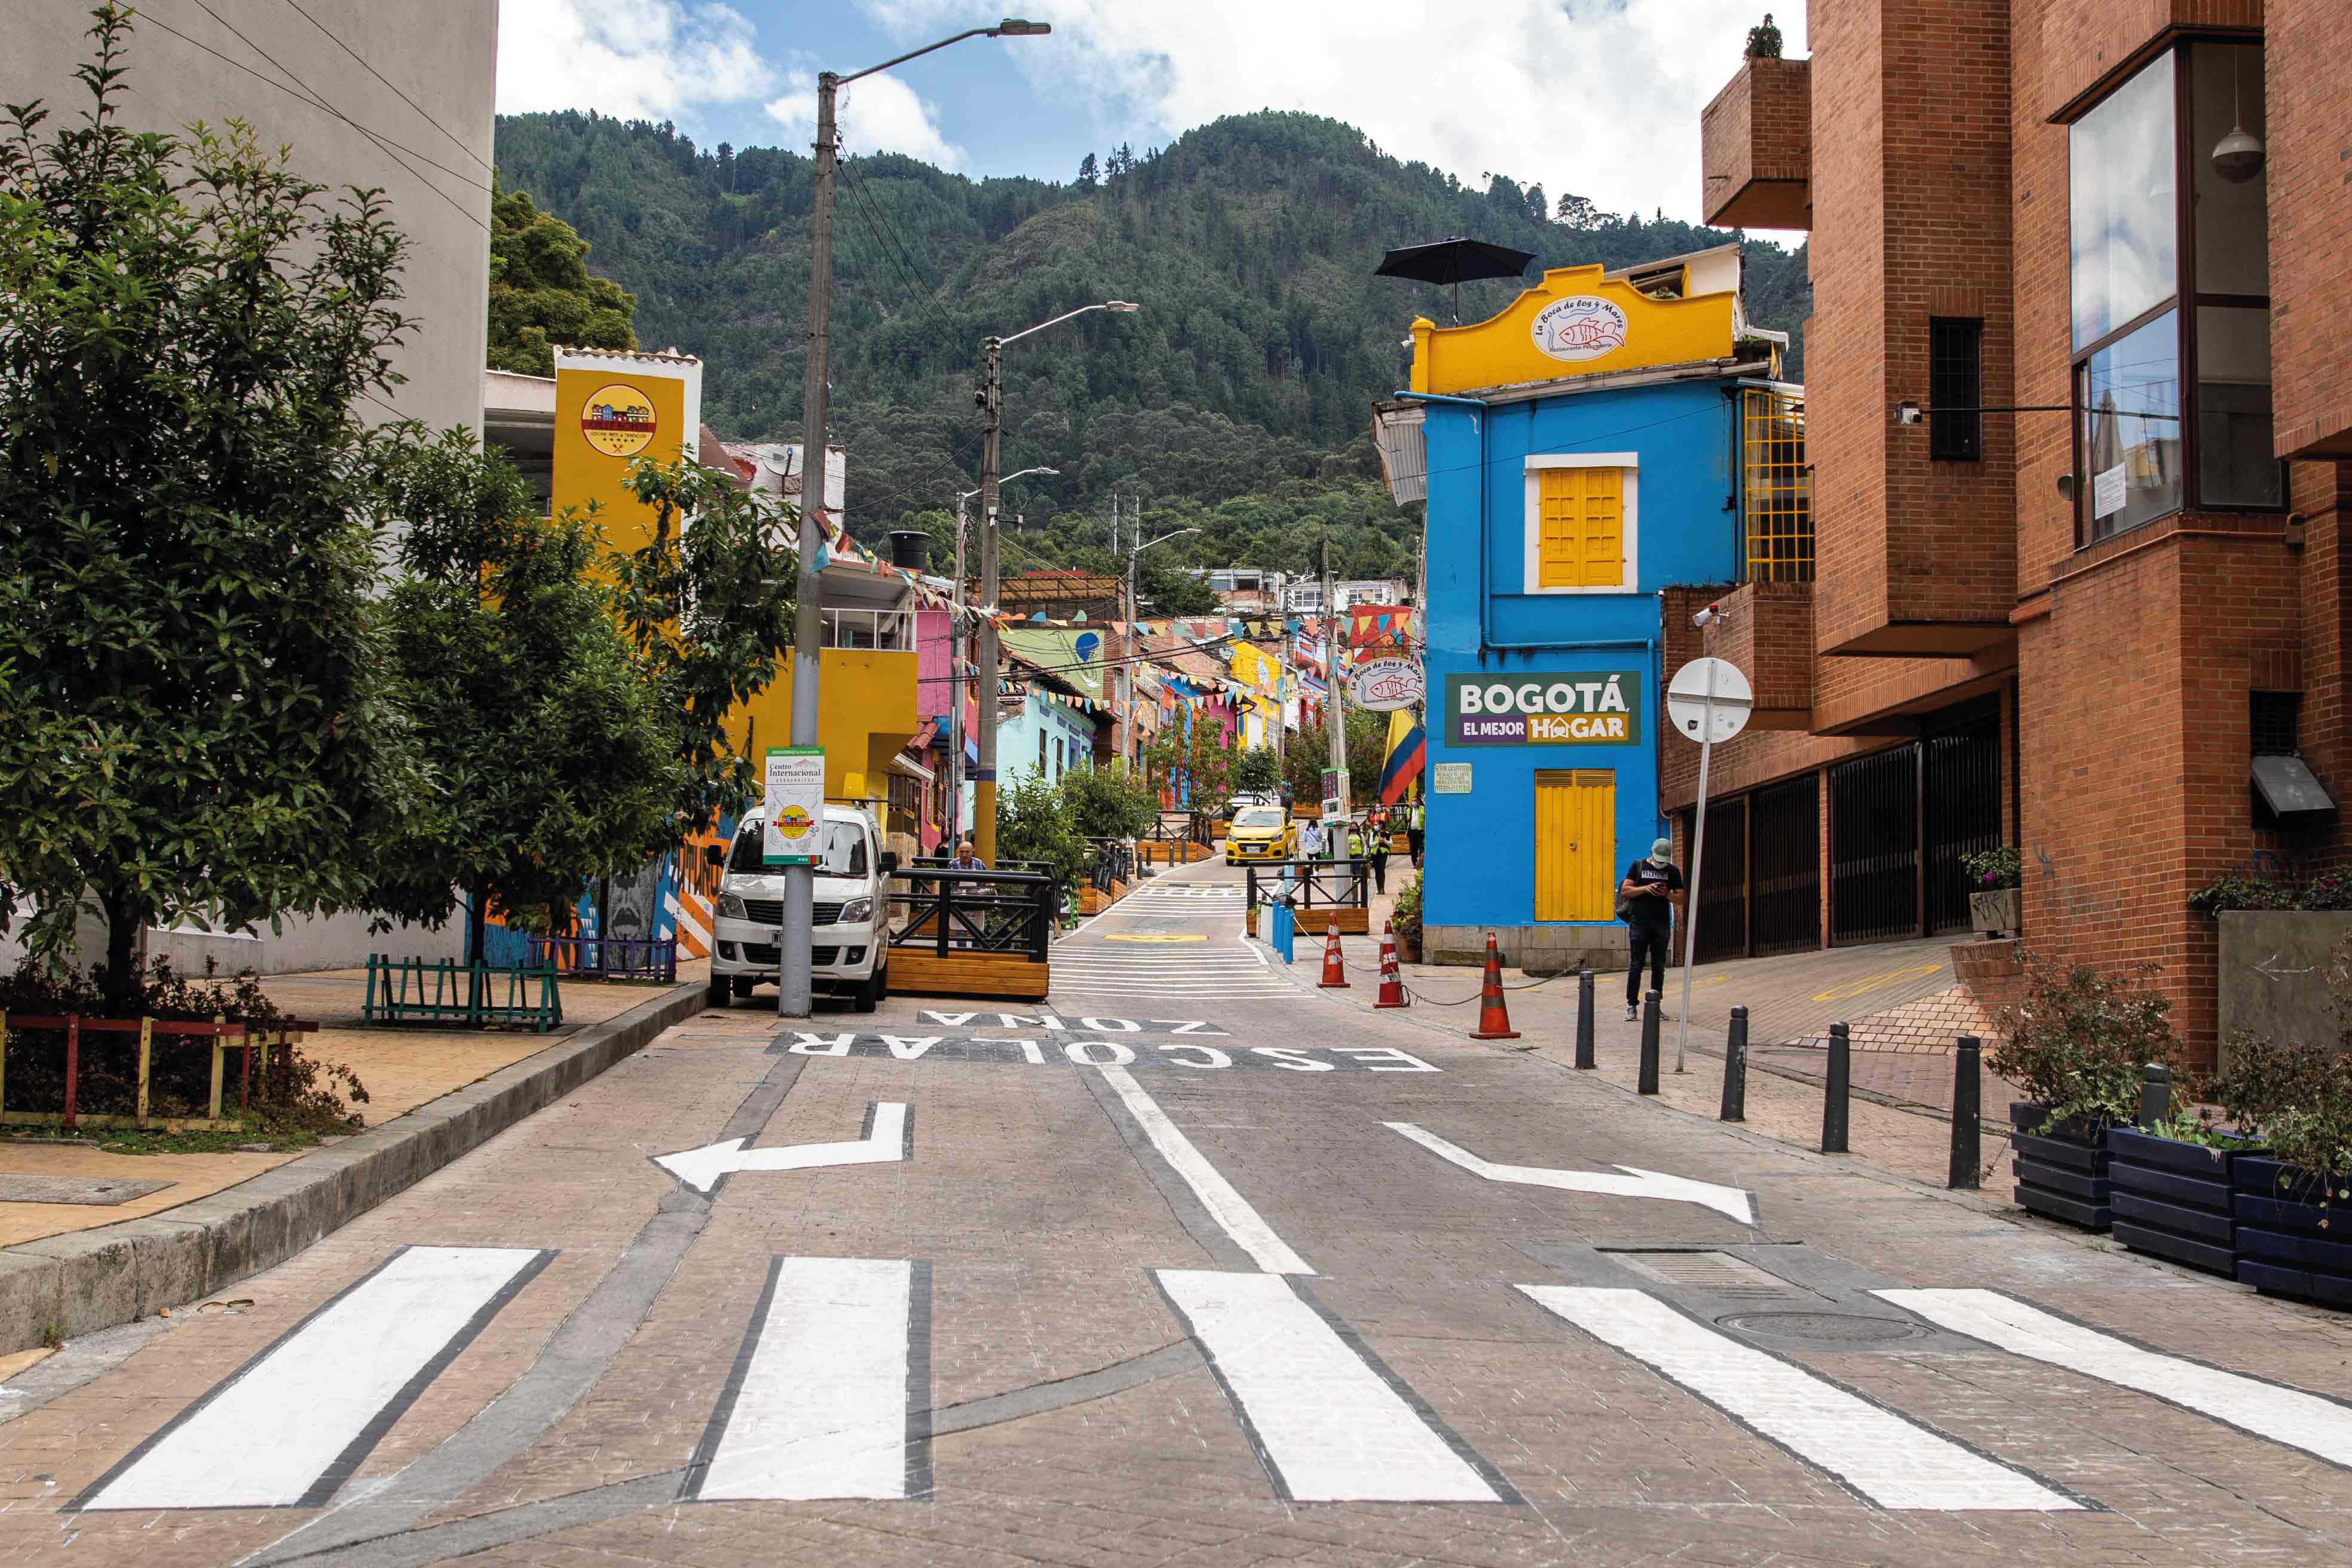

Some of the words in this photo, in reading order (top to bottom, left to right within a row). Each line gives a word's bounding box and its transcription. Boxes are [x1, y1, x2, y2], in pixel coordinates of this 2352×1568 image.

[1536, 325, 1543, 335] La
[1541, 307, 1562, 323] Boca
[1564, 301, 1574, 310] de
[1602, 304, 1624, 329] Mares
[1350, 682, 1356, 690] La
[1354, 666, 1371, 681] Boca
[1404, 663, 1423, 683] Mares
[1463, 722, 1478, 736] EL
[1480, 722, 1525, 736] MEJOR
[769, 768, 821, 777] Internacional
[921, 1010, 1232, 1036] ZONA
[788, 1031, 1444, 1071] ESCOLAR
